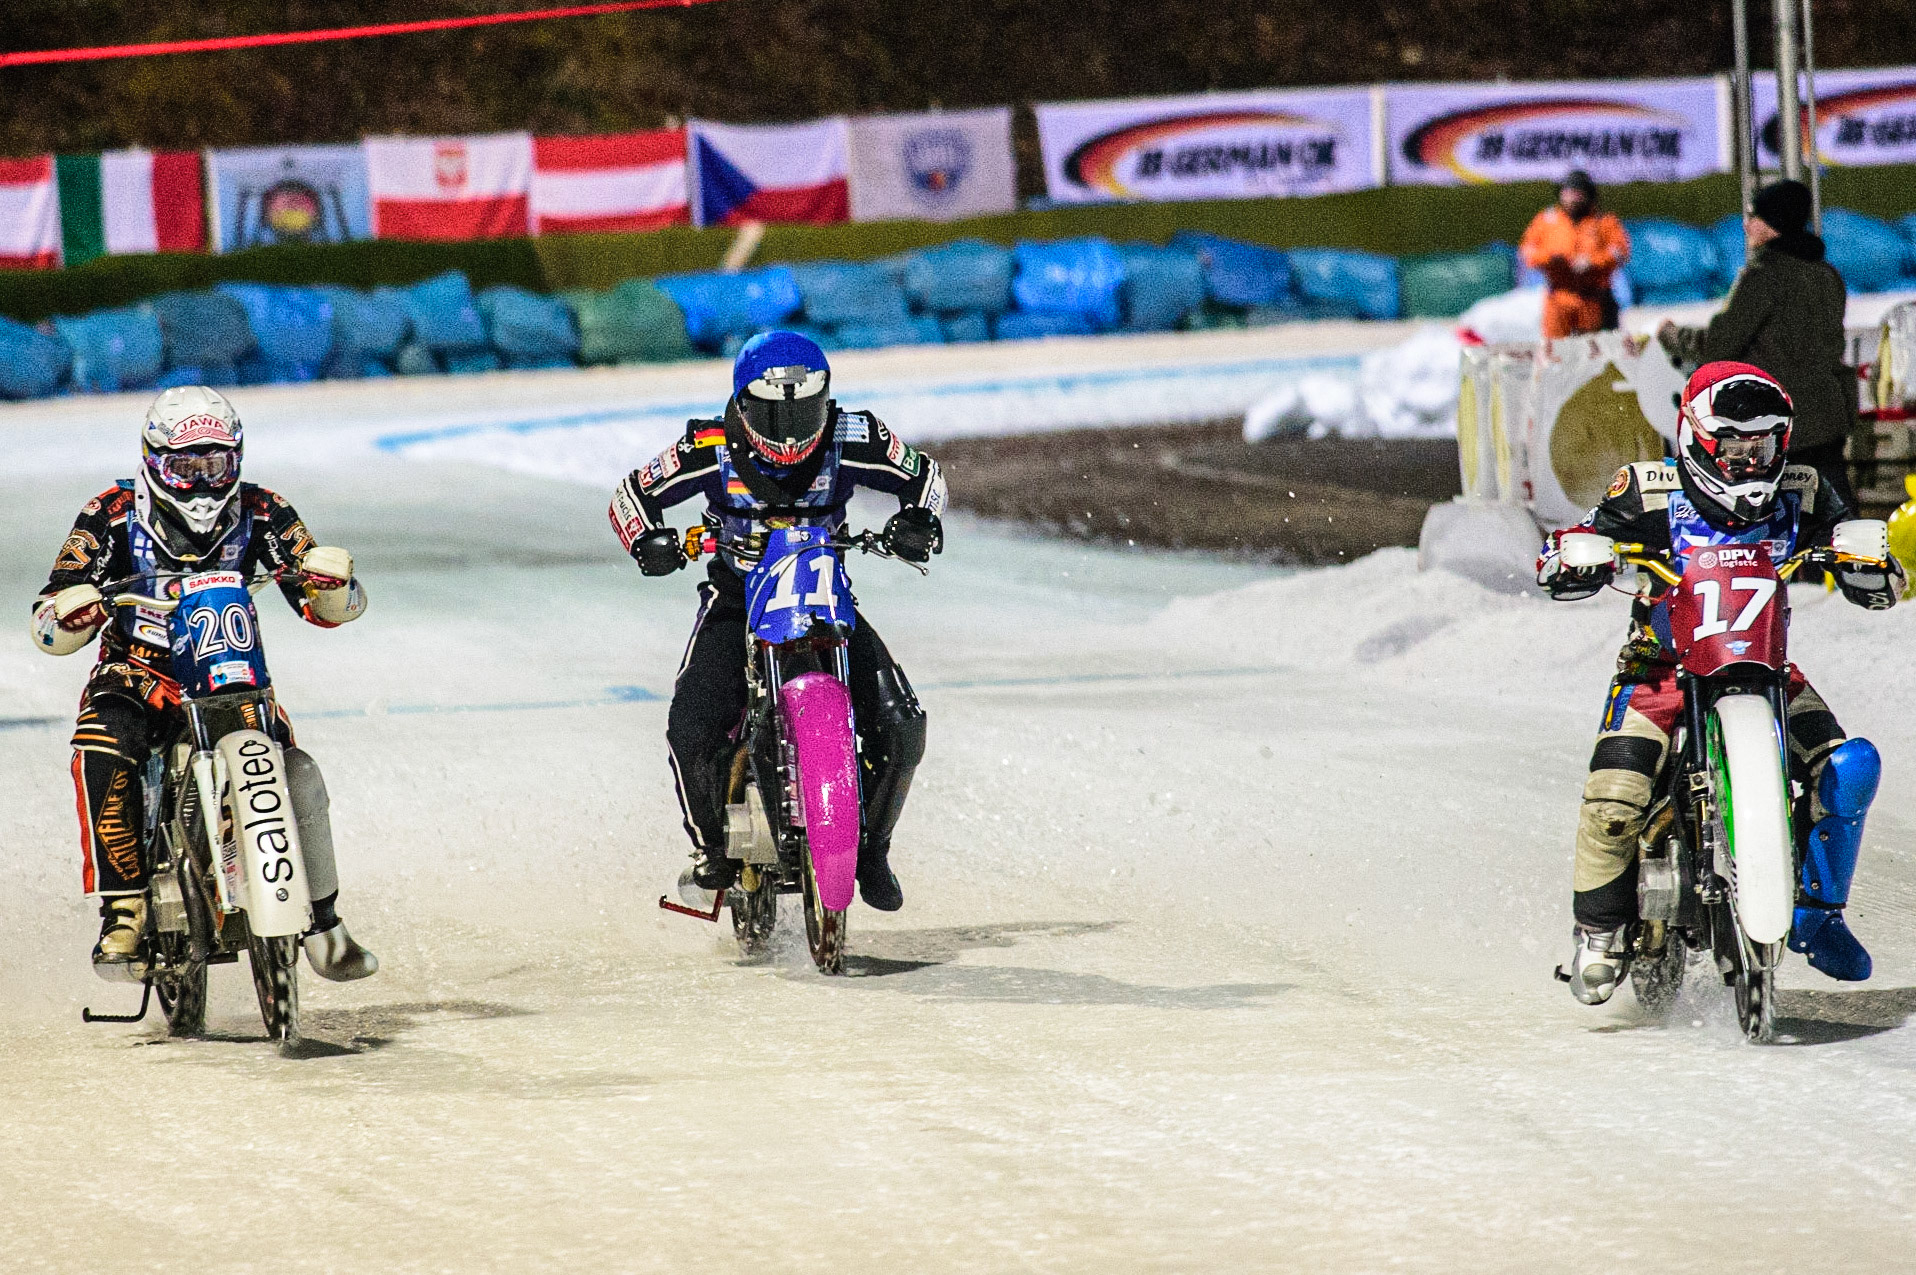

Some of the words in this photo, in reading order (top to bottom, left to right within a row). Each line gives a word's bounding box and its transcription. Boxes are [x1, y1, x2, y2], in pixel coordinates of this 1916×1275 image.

[180, 417, 224, 433] JAWA
[1718, 549, 1757, 561] DPV
[1720, 560, 1759, 568] logistic
[189, 575, 236, 589] SAVIKKO
[765, 553, 838, 613] 11
[1693, 577, 1777, 642] 17
[188, 602, 255, 662] 20
